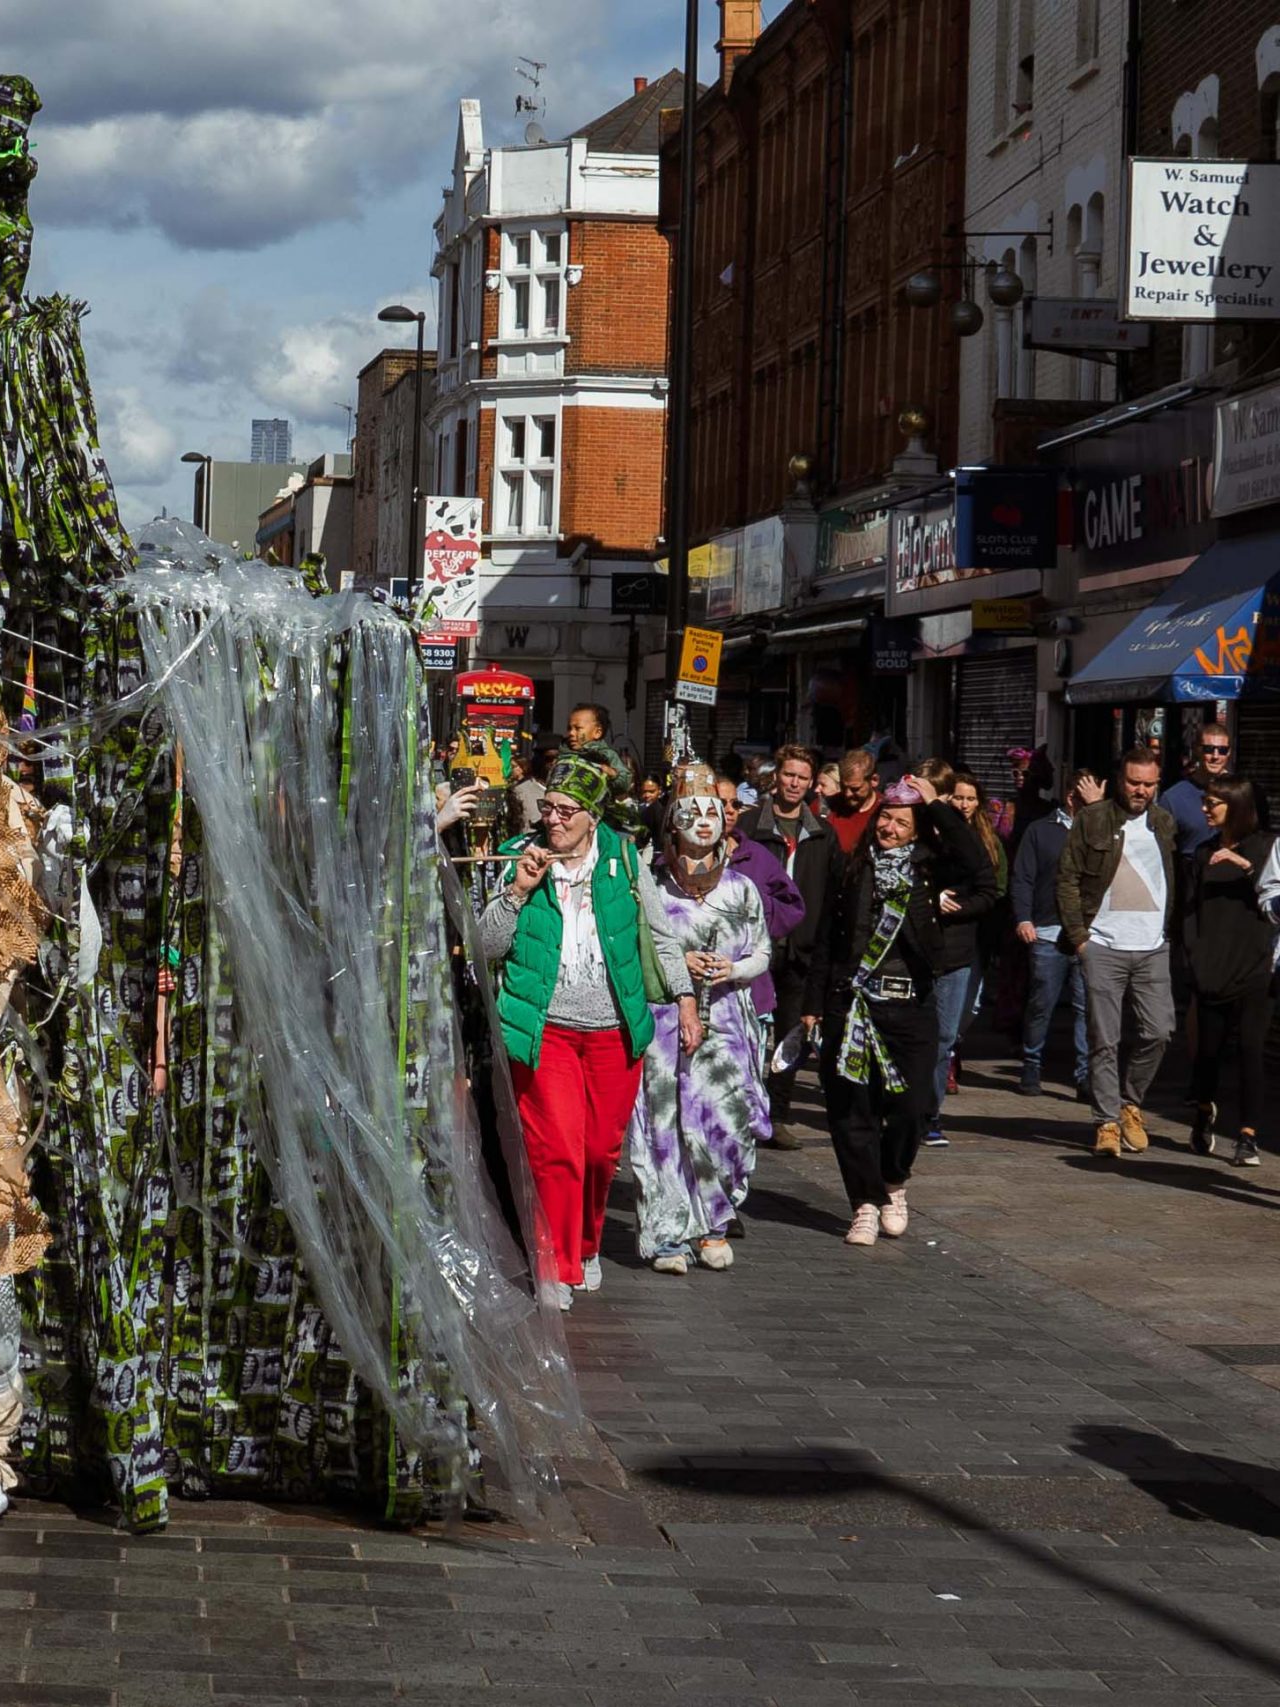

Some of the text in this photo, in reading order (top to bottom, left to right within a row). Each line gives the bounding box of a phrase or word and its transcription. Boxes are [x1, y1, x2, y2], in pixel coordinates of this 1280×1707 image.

[1164, 168, 1250, 185] W. Samuel
[1160, 190, 1250, 217] Watch
[1193, 224, 1221, 247] &
[1138, 251, 1273, 288] Jewellery
[1134, 286, 1274, 308] Repair Specialist
[1084, 474, 1143, 551] GAME
[1010, 534, 1039, 545] CLUB
[989, 546, 1033, 556] LOUNGE
[505, 625, 530, 649] W
[876, 659, 909, 669] GOLD
